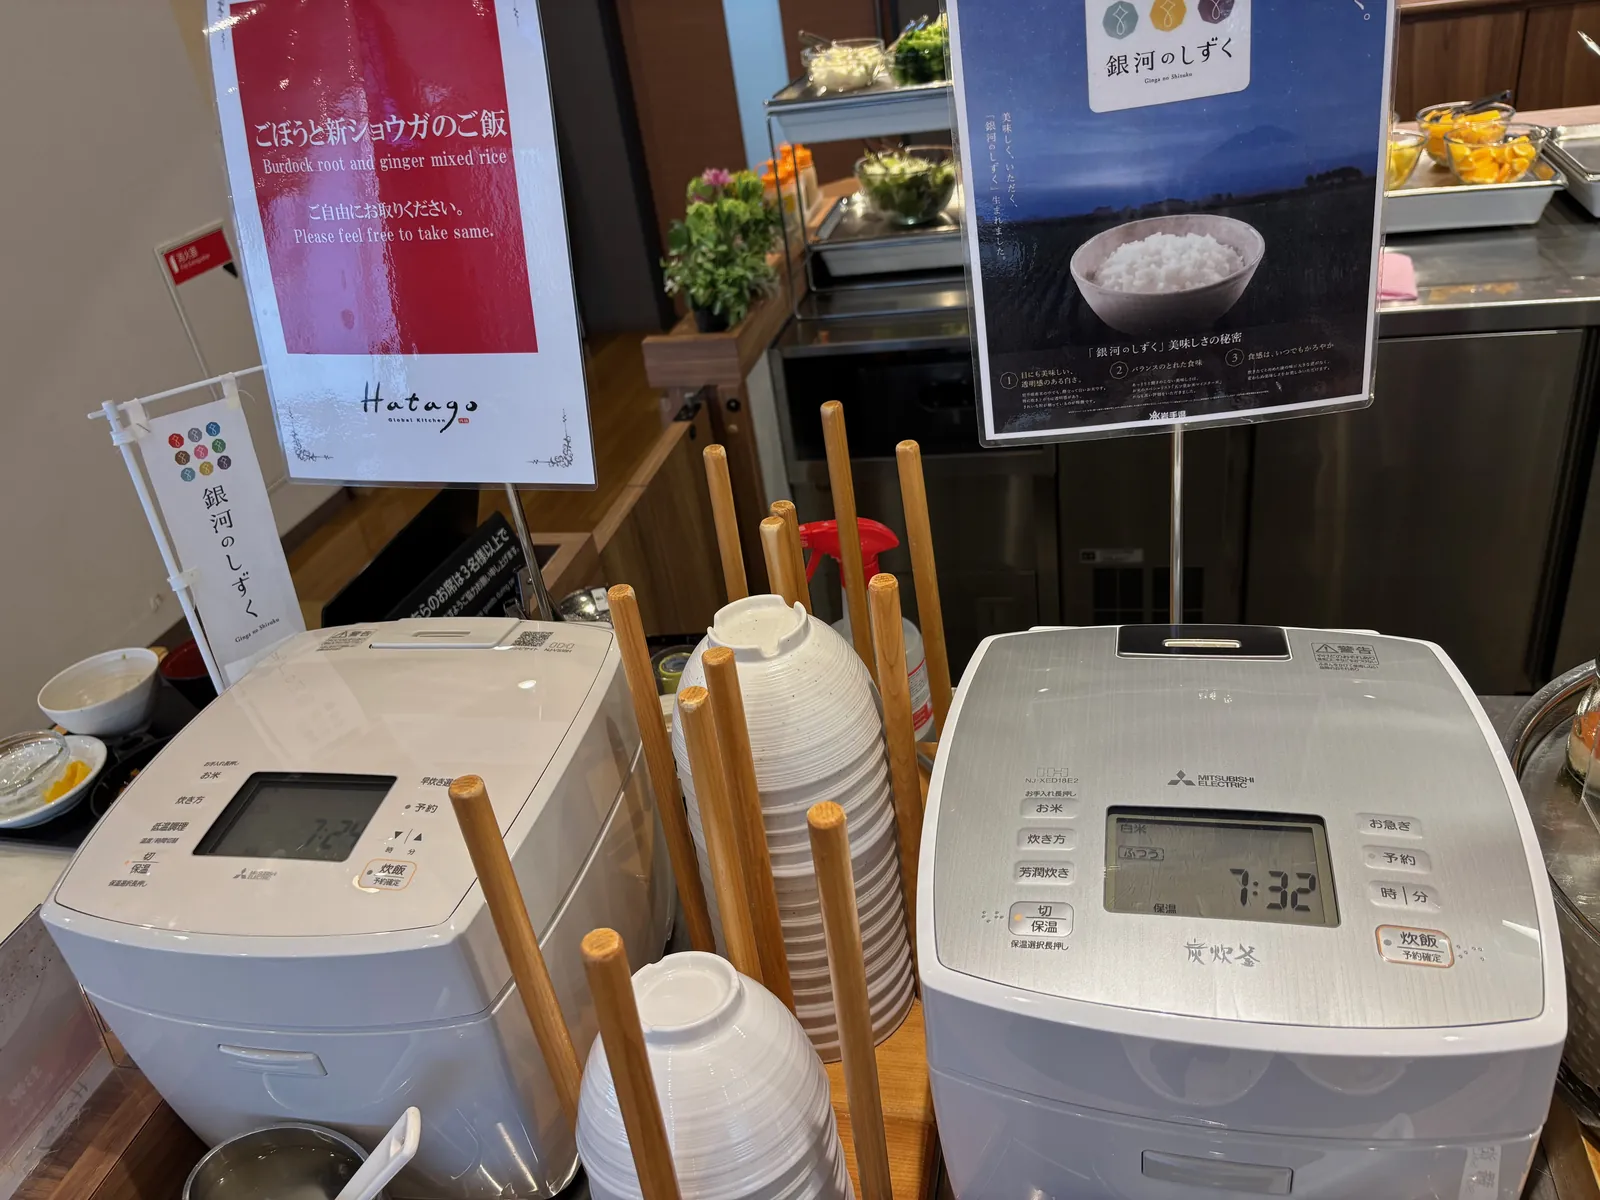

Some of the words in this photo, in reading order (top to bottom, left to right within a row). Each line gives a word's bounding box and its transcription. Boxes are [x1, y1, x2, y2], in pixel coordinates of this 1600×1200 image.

[1106, 36, 1234, 77] 銀河のしずく
[254, 109, 508, 148] ごぼうと新ショウガのご飯
[262, 158, 314, 175] Burdock
[318, 157, 345, 172] root
[350, 155, 375, 171] and
[380, 153, 426, 171] ginger
[431, 150, 474, 168] mixed
[478, 149, 507, 165] rice
[308, 200, 464, 222] ご自由にお取りください。
[294, 228, 336, 244] Please
[338, 228, 364, 243] feel
[368, 227, 395, 242] free
[399, 227, 413, 241] to
[418, 225, 449, 240] take
[454, 226, 494, 240] same.
[361, 381, 478, 433] Hatago
[202, 485, 258, 618] 銀河のしずく
[200, 771, 222, 780] お米
[1198, 774, 1254, 784] MITSUBISHI
[1197, 780, 1248, 789] ELECTRIC
[174, 796, 206, 805] 炊き方
[414, 803, 439, 813] 予約
[1036, 803, 1063, 813] お米
[150, 821, 190, 832] 低温調理
[1120, 824, 1147, 835] 白米
[1369, 818, 1411, 832] お急ぎ
[1027, 833, 1067, 845] 炊き方
[143, 852, 156, 861] 切
[407, 848, 416, 856] 分
[1123, 847, 1160, 860] ふつう
[1383, 851, 1416, 866] 予約
[130, 863, 151, 874] 保温
[379, 863, 408, 876] 炊飯
[1019, 866, 1070, 879] 芳潤炊き
[1229, 868, 1317, 912] 7:32
[1380, 887, 1397, 900] 時
[1412, 890, 1429, 903] 分
[1038, 905, 1053, 917] 切
[1153, 903, 1177, 914] 保温
[1031, 920, 1058, 933] 保温
[1011, 939, 1069, 951] 保温選択長押し
[1400, 931, 1439, 949] 炊飯
[1184, 938, 1261, 968] 炭炊釜
[1402, 950, 1442, 964] 予約確定
